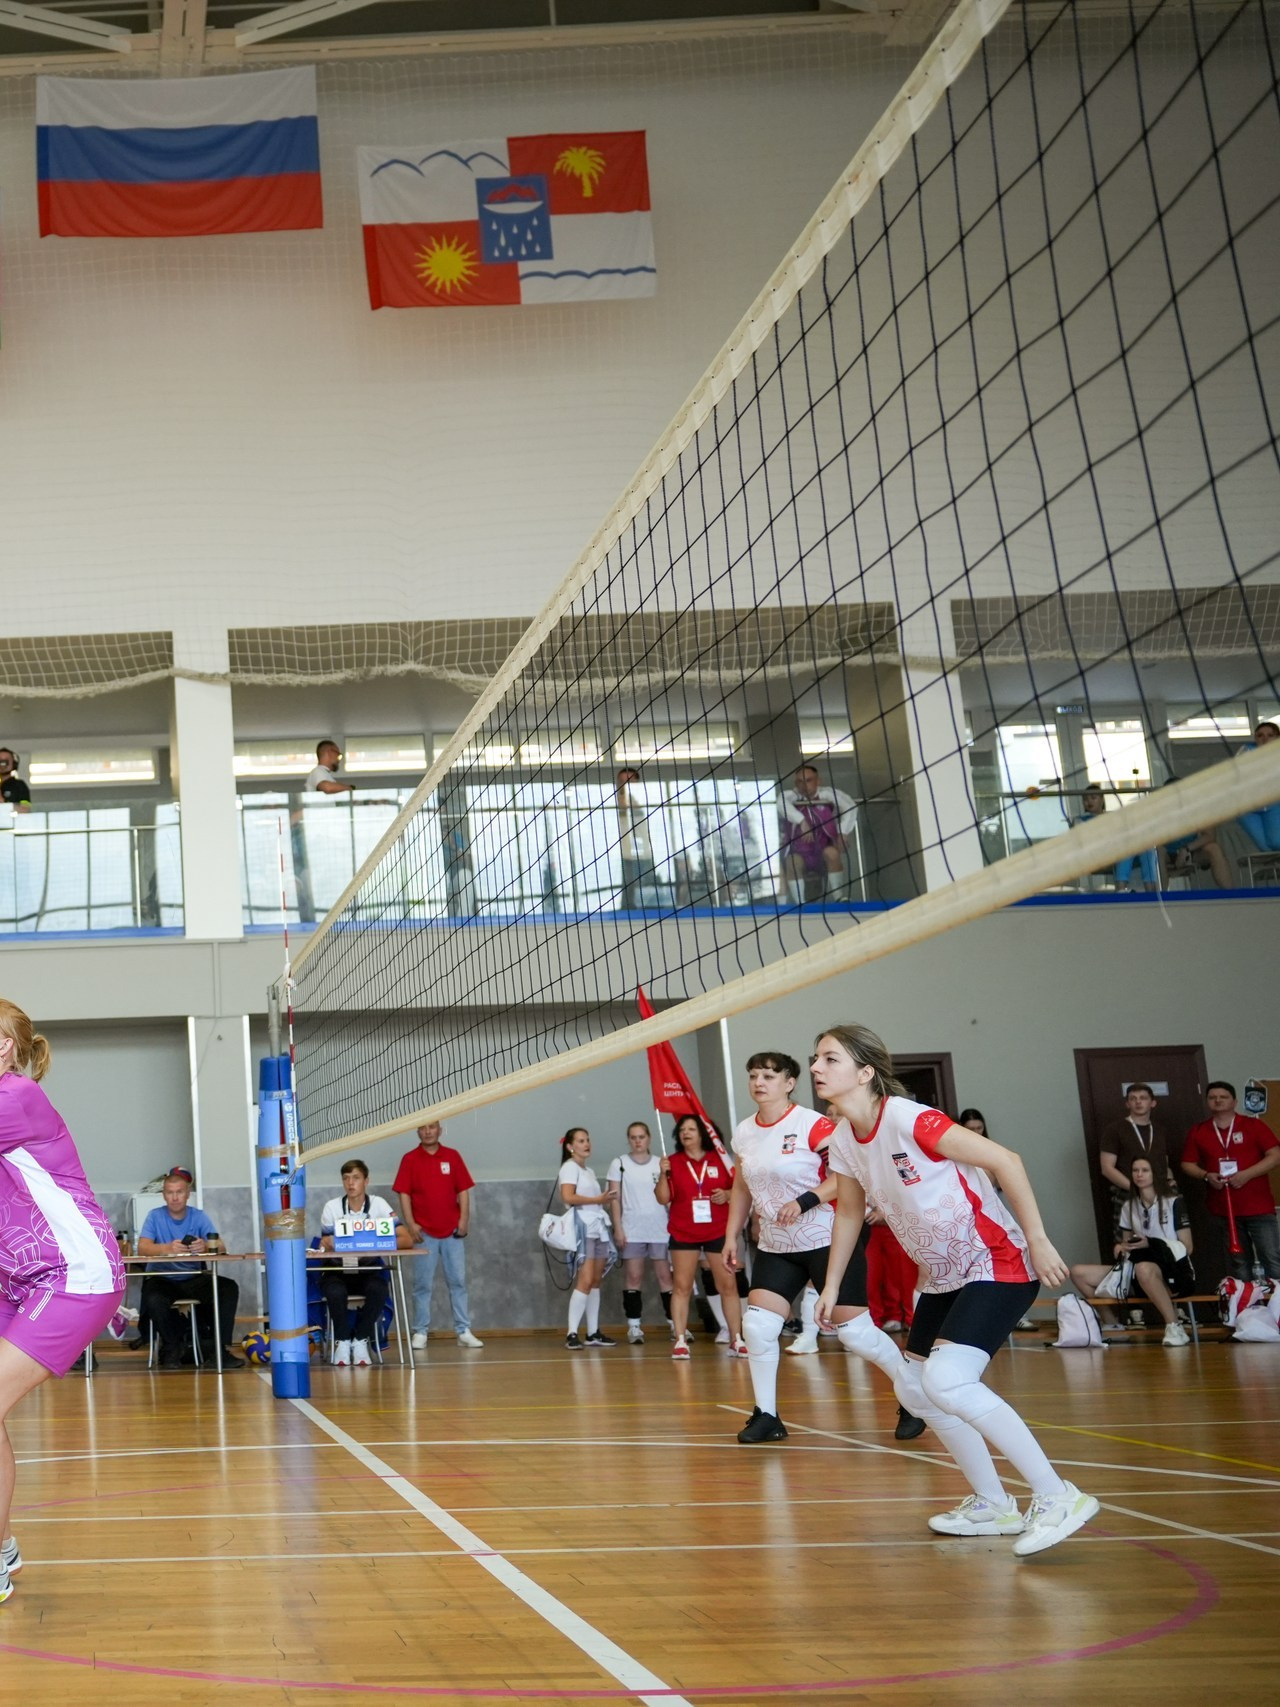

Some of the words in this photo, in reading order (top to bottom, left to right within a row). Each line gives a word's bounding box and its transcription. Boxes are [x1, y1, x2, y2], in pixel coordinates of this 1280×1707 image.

[341, 1222, 348, 1235] 1
[354, 1221, 363, 1230] 0
[380, 1221, 391, 1235] 3
